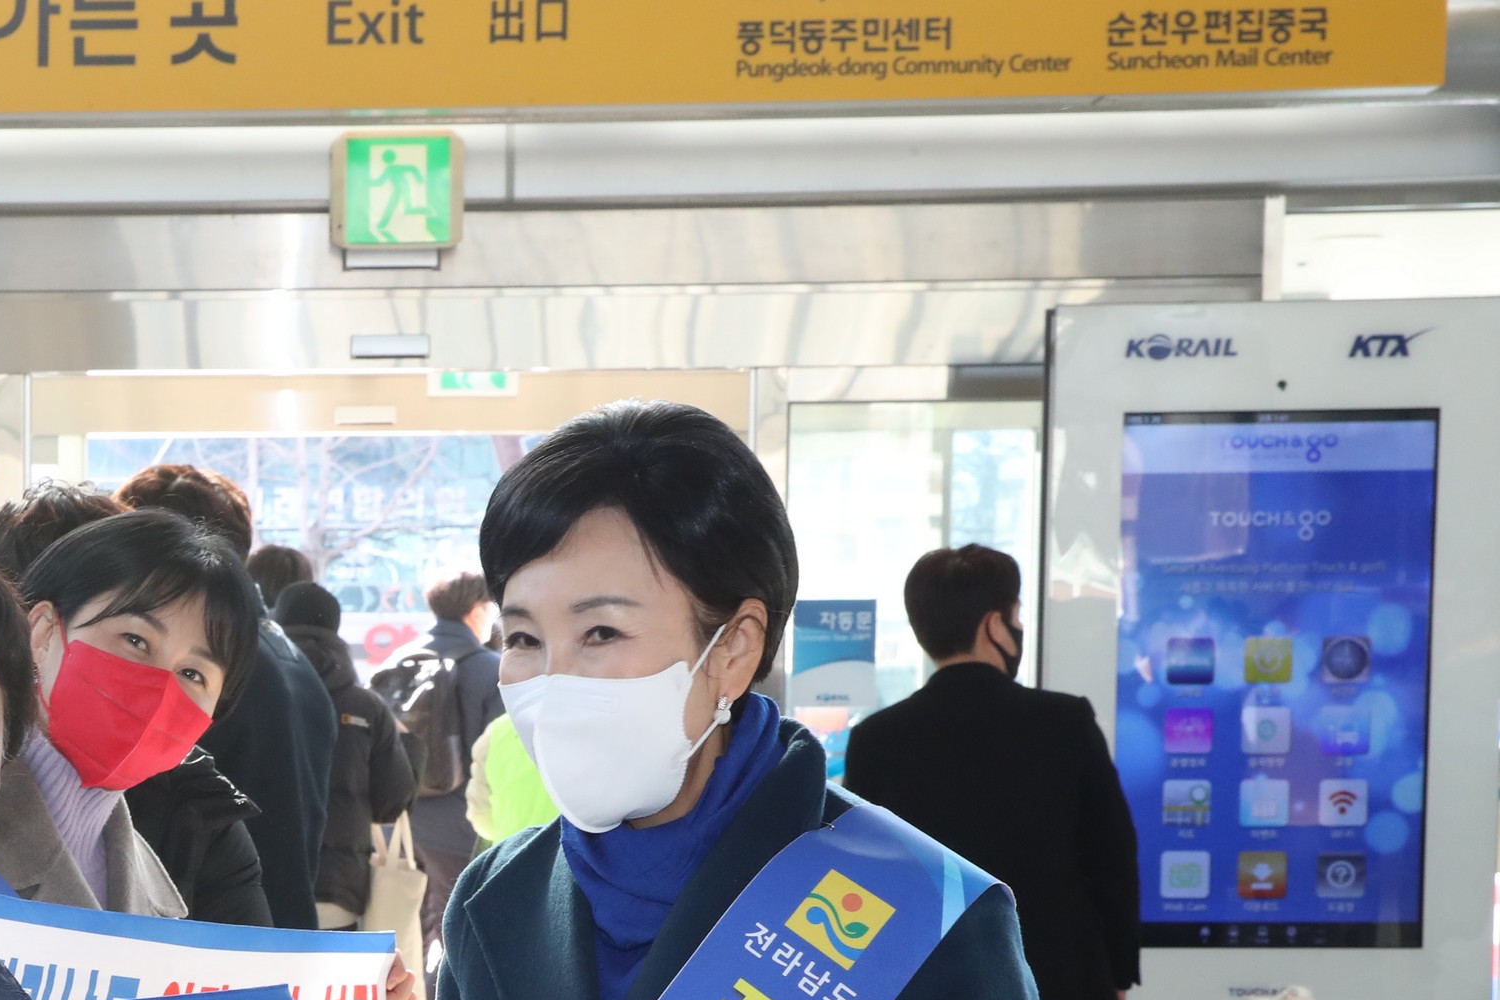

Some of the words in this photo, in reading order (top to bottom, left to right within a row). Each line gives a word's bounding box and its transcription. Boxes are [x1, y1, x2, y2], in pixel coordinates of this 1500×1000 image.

[327, 0, 424, 45] Exit
[489, 0, 568, 43] 出口
[737, 17, 952, 55] 풍덕동주민센터
[1107, 7, 1329, 46] 순천우편집중국
[736, 58, 887, 82] Pungdeok-dong
[893, 55, 1004, 78] Community
[1009, 53, 1072, 74] Center
[1107, 50, 1208, 71] Suncheon
[1215, 48, 1258, 67] Mail
[1265, 47, 1333, 66] Center
[1125, 333, 1238, 361] KORAIL
[1348, 331, 1422, 358] KTX
[819, 611, 872, 632] 자동문
